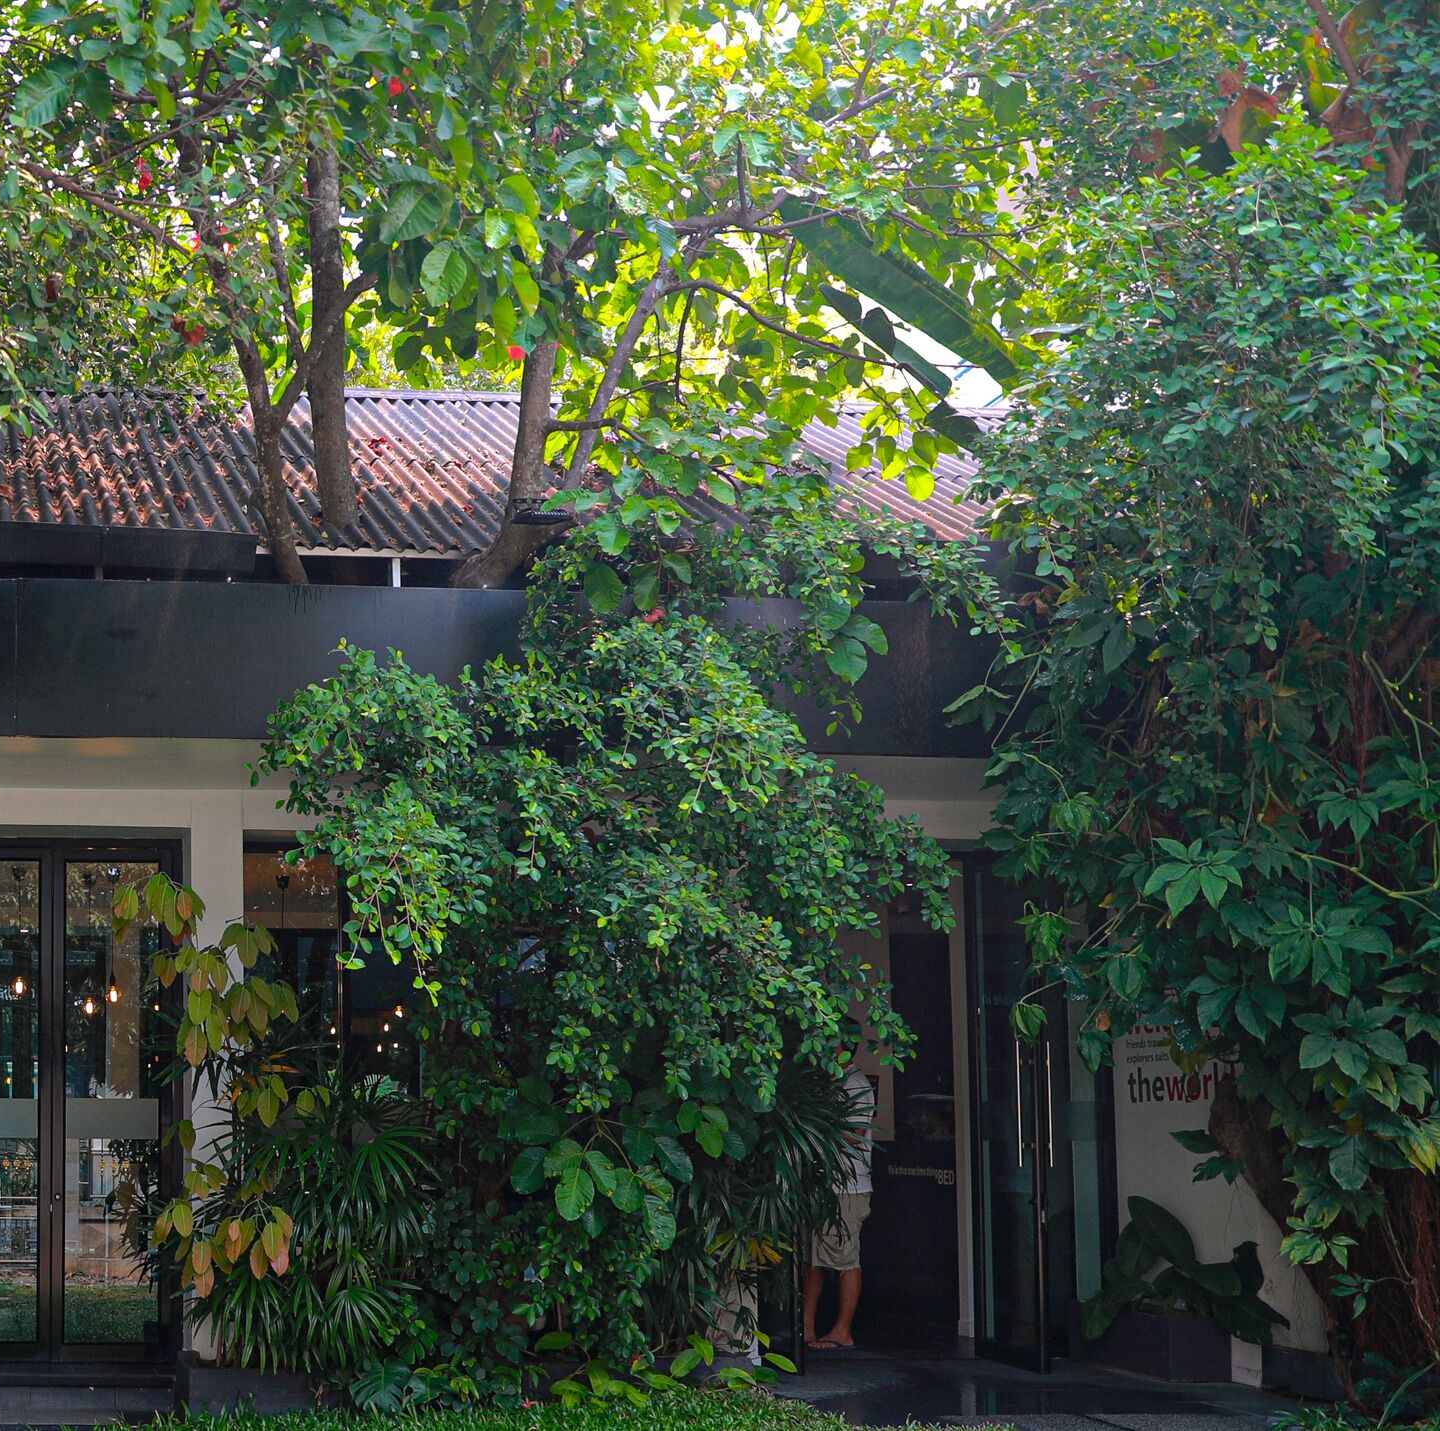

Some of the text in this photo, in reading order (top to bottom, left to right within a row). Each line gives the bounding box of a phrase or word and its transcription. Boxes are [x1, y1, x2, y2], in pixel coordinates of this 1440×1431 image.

[1126, 1039, 1147, 1049] friends
[1126, 1051, 1169, 1065] explorers suits
[938, 1169, 955, 1185] BED
